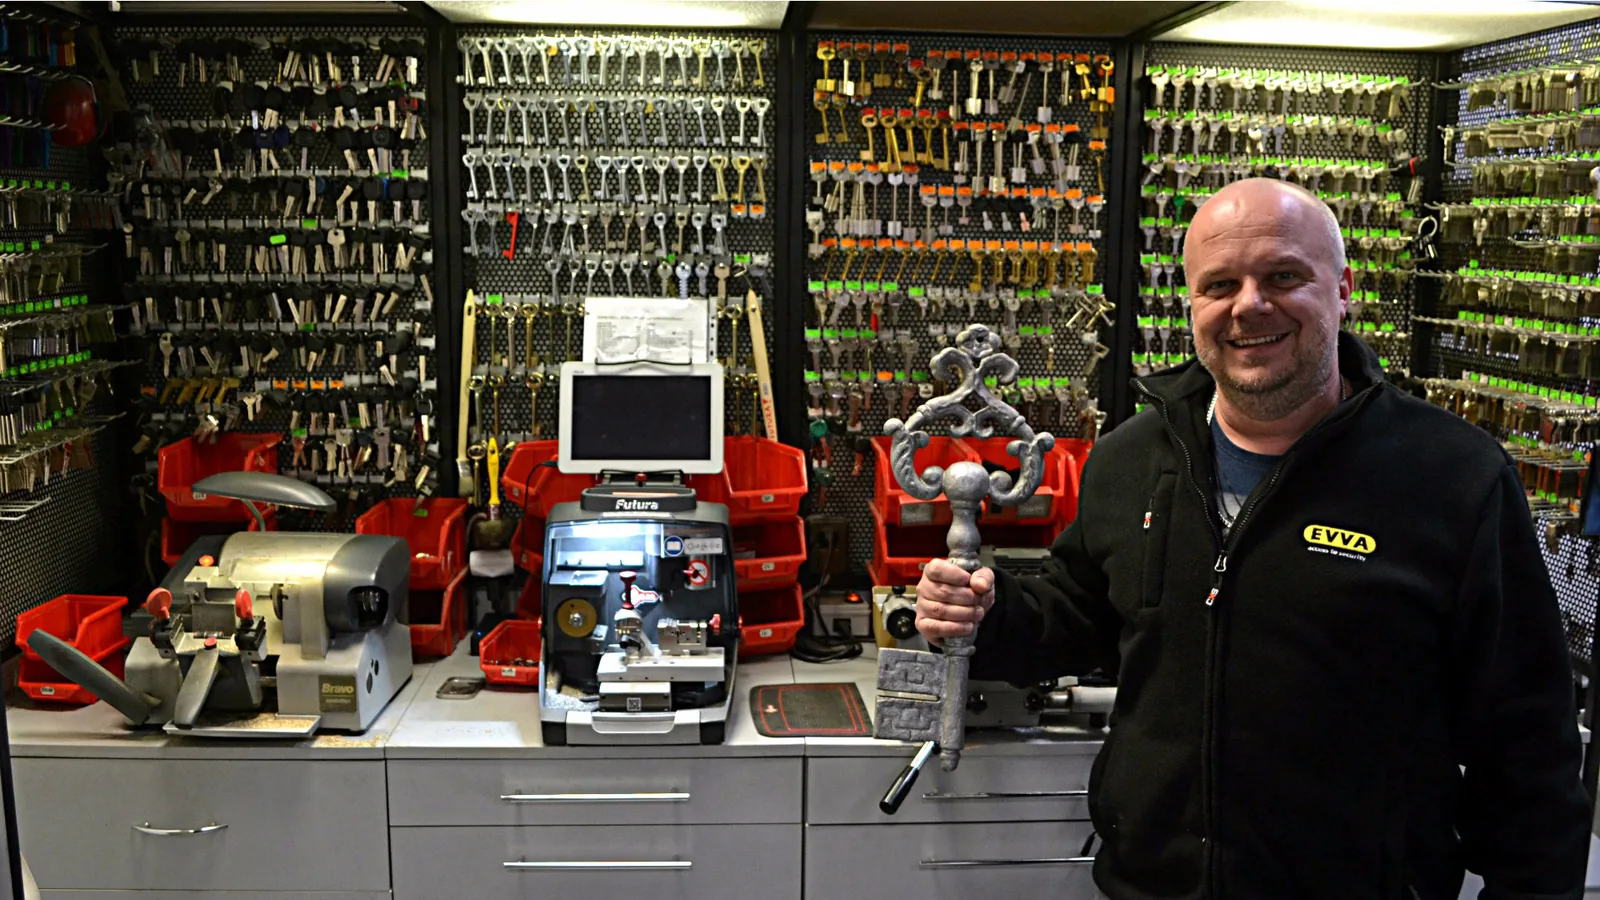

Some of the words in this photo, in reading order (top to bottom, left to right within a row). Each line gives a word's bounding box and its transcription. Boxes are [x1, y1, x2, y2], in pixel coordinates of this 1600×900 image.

[615, 499, 659, 510] Futura
[1311, 527, 1369, 551] EVVA
[1338, 551, 1366, 562] security
[322, 683, 354, 694] Bravo
